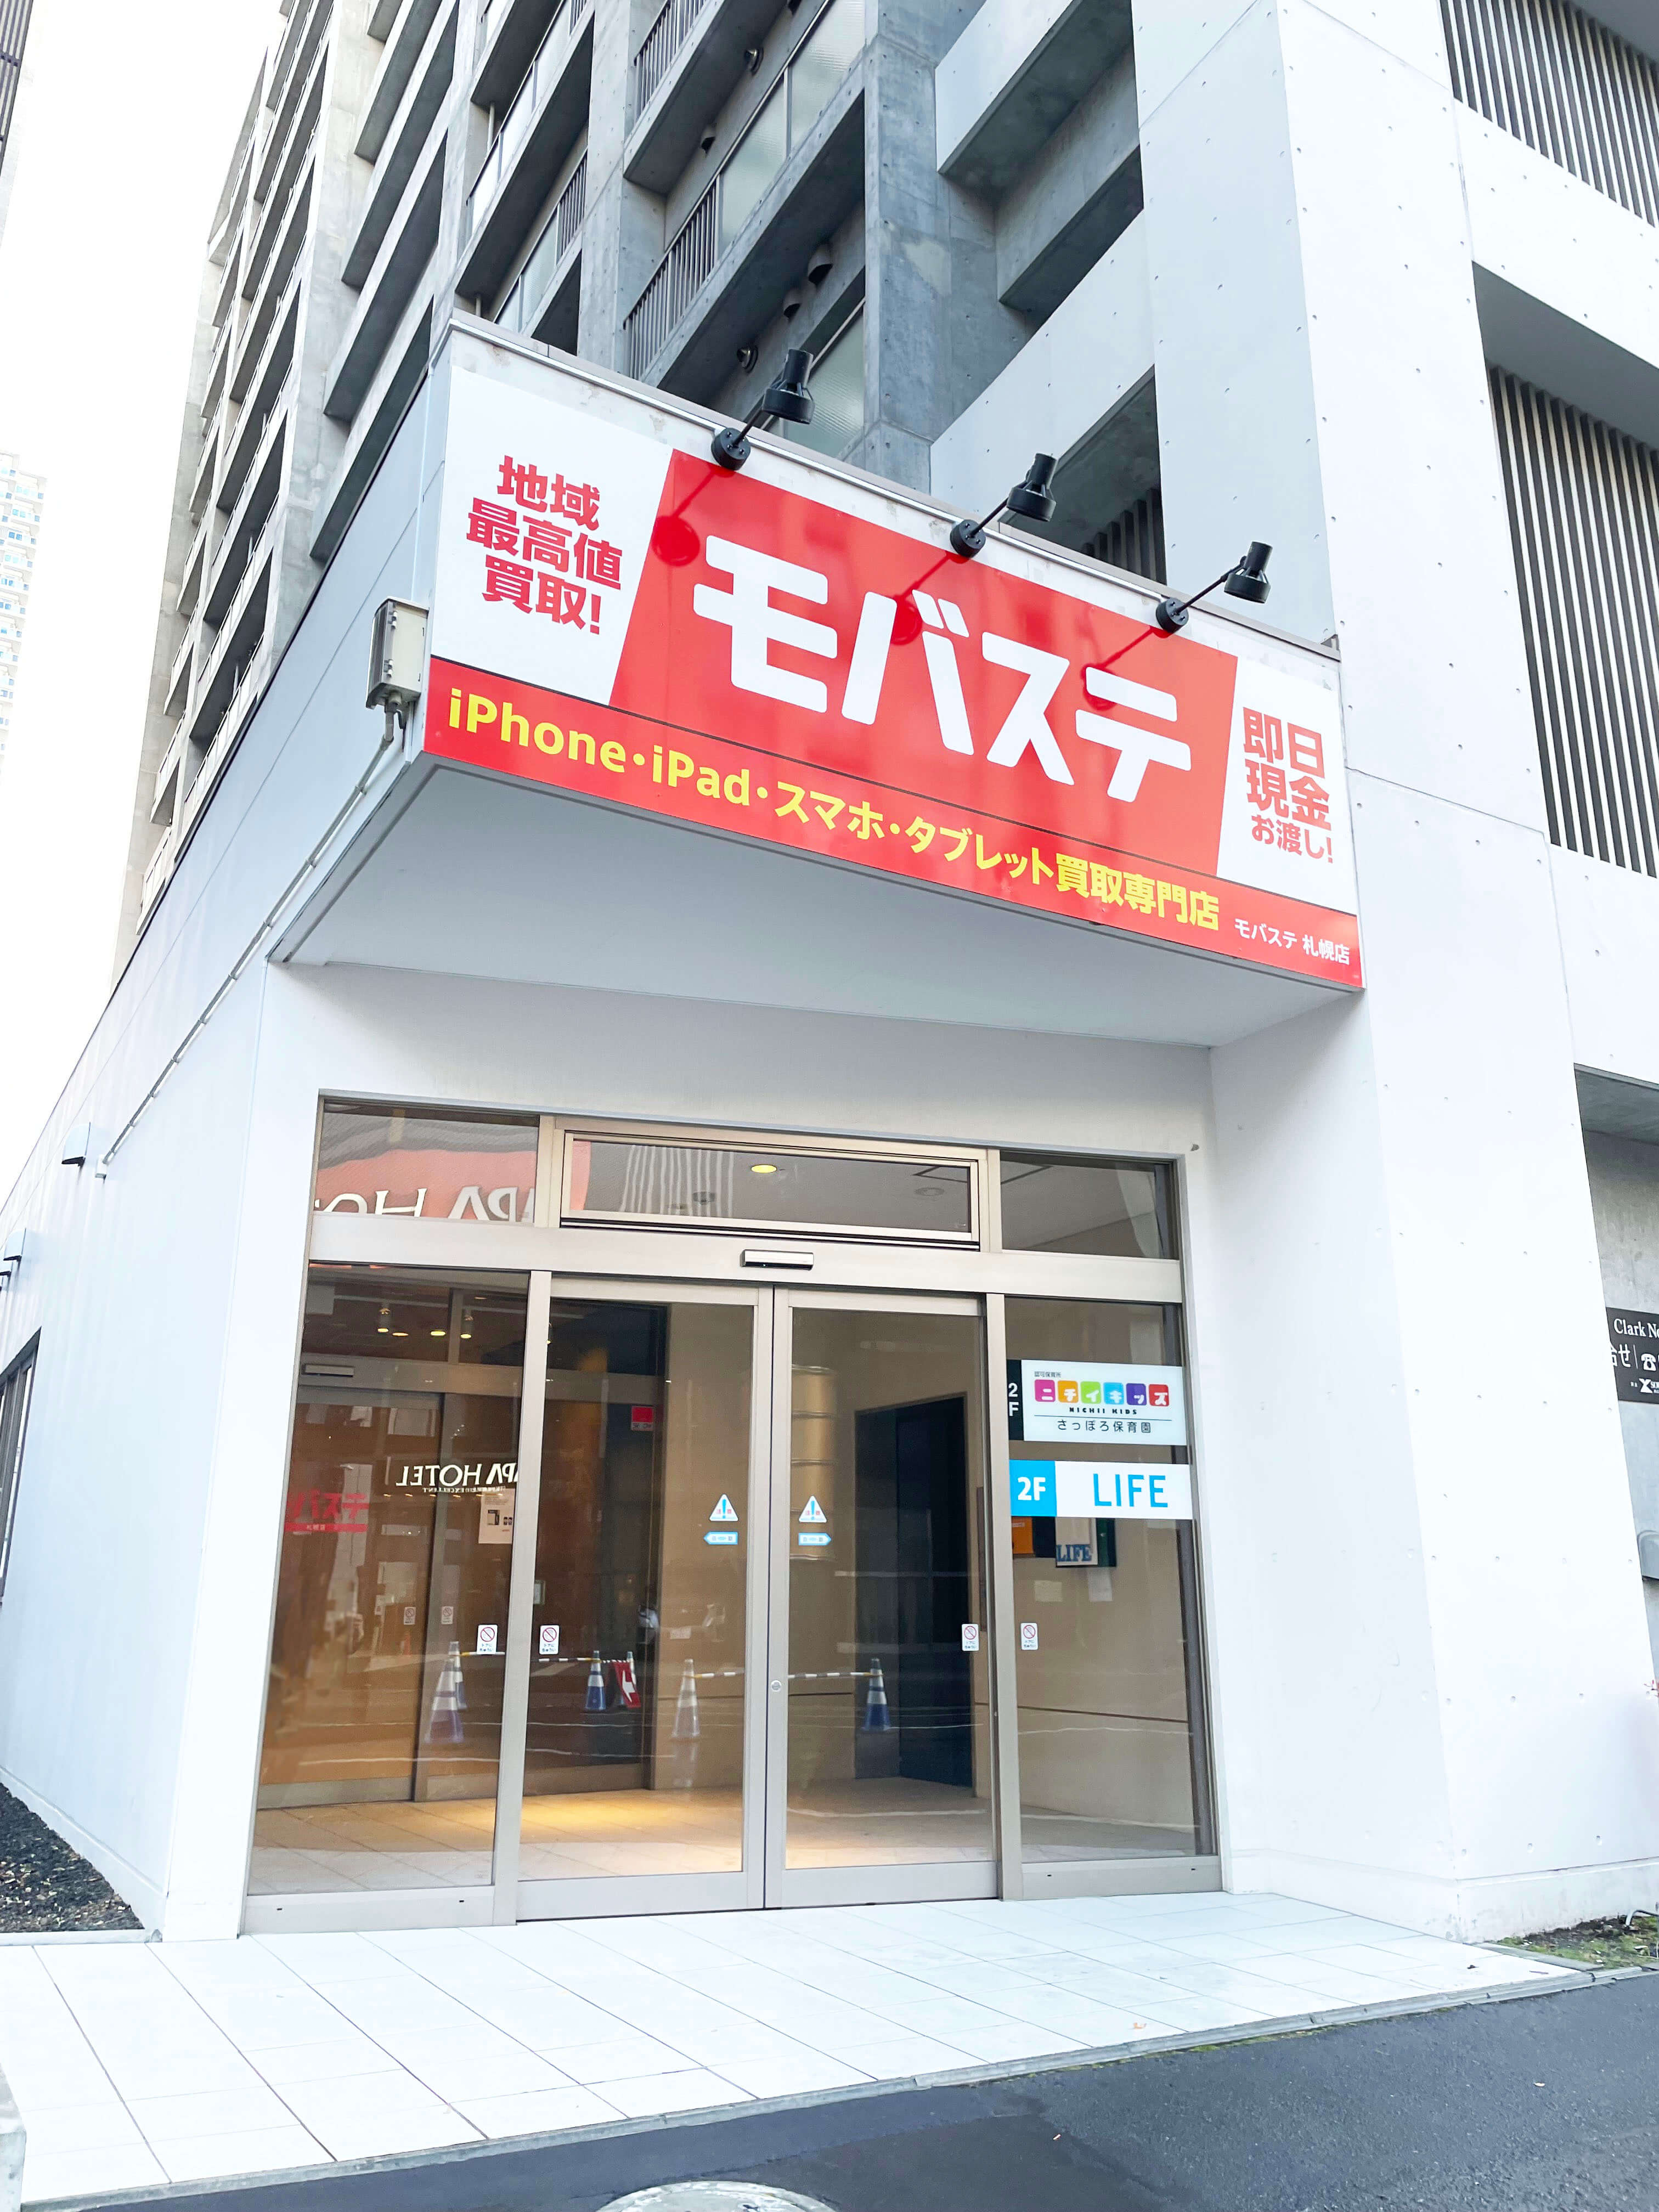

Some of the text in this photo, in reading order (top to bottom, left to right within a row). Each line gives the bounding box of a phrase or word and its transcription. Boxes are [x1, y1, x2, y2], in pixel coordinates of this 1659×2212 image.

[496, 455, 600, 531] 地域
[466, 498, 623, 590] 最高値
[482, 555, 602, 635] 買取!
[693, 535, 1192, 803] モバステ
[1243, 707, 1325, 779] 即日
[1244, 758, 1332, 831] 現金
[1251, 814, 1333, 864] お渡し!
[1234, 918, 1350, 966] モバステ 札幌店
[1613, 1318, 1646, 1338] Clark
[1057, 1419, 1152, 1434] さっぽろ保育園
[1017, 1473, 1168, 1508] 2F LIFE
[1056, 1544, 1092, 1562] LIFE
